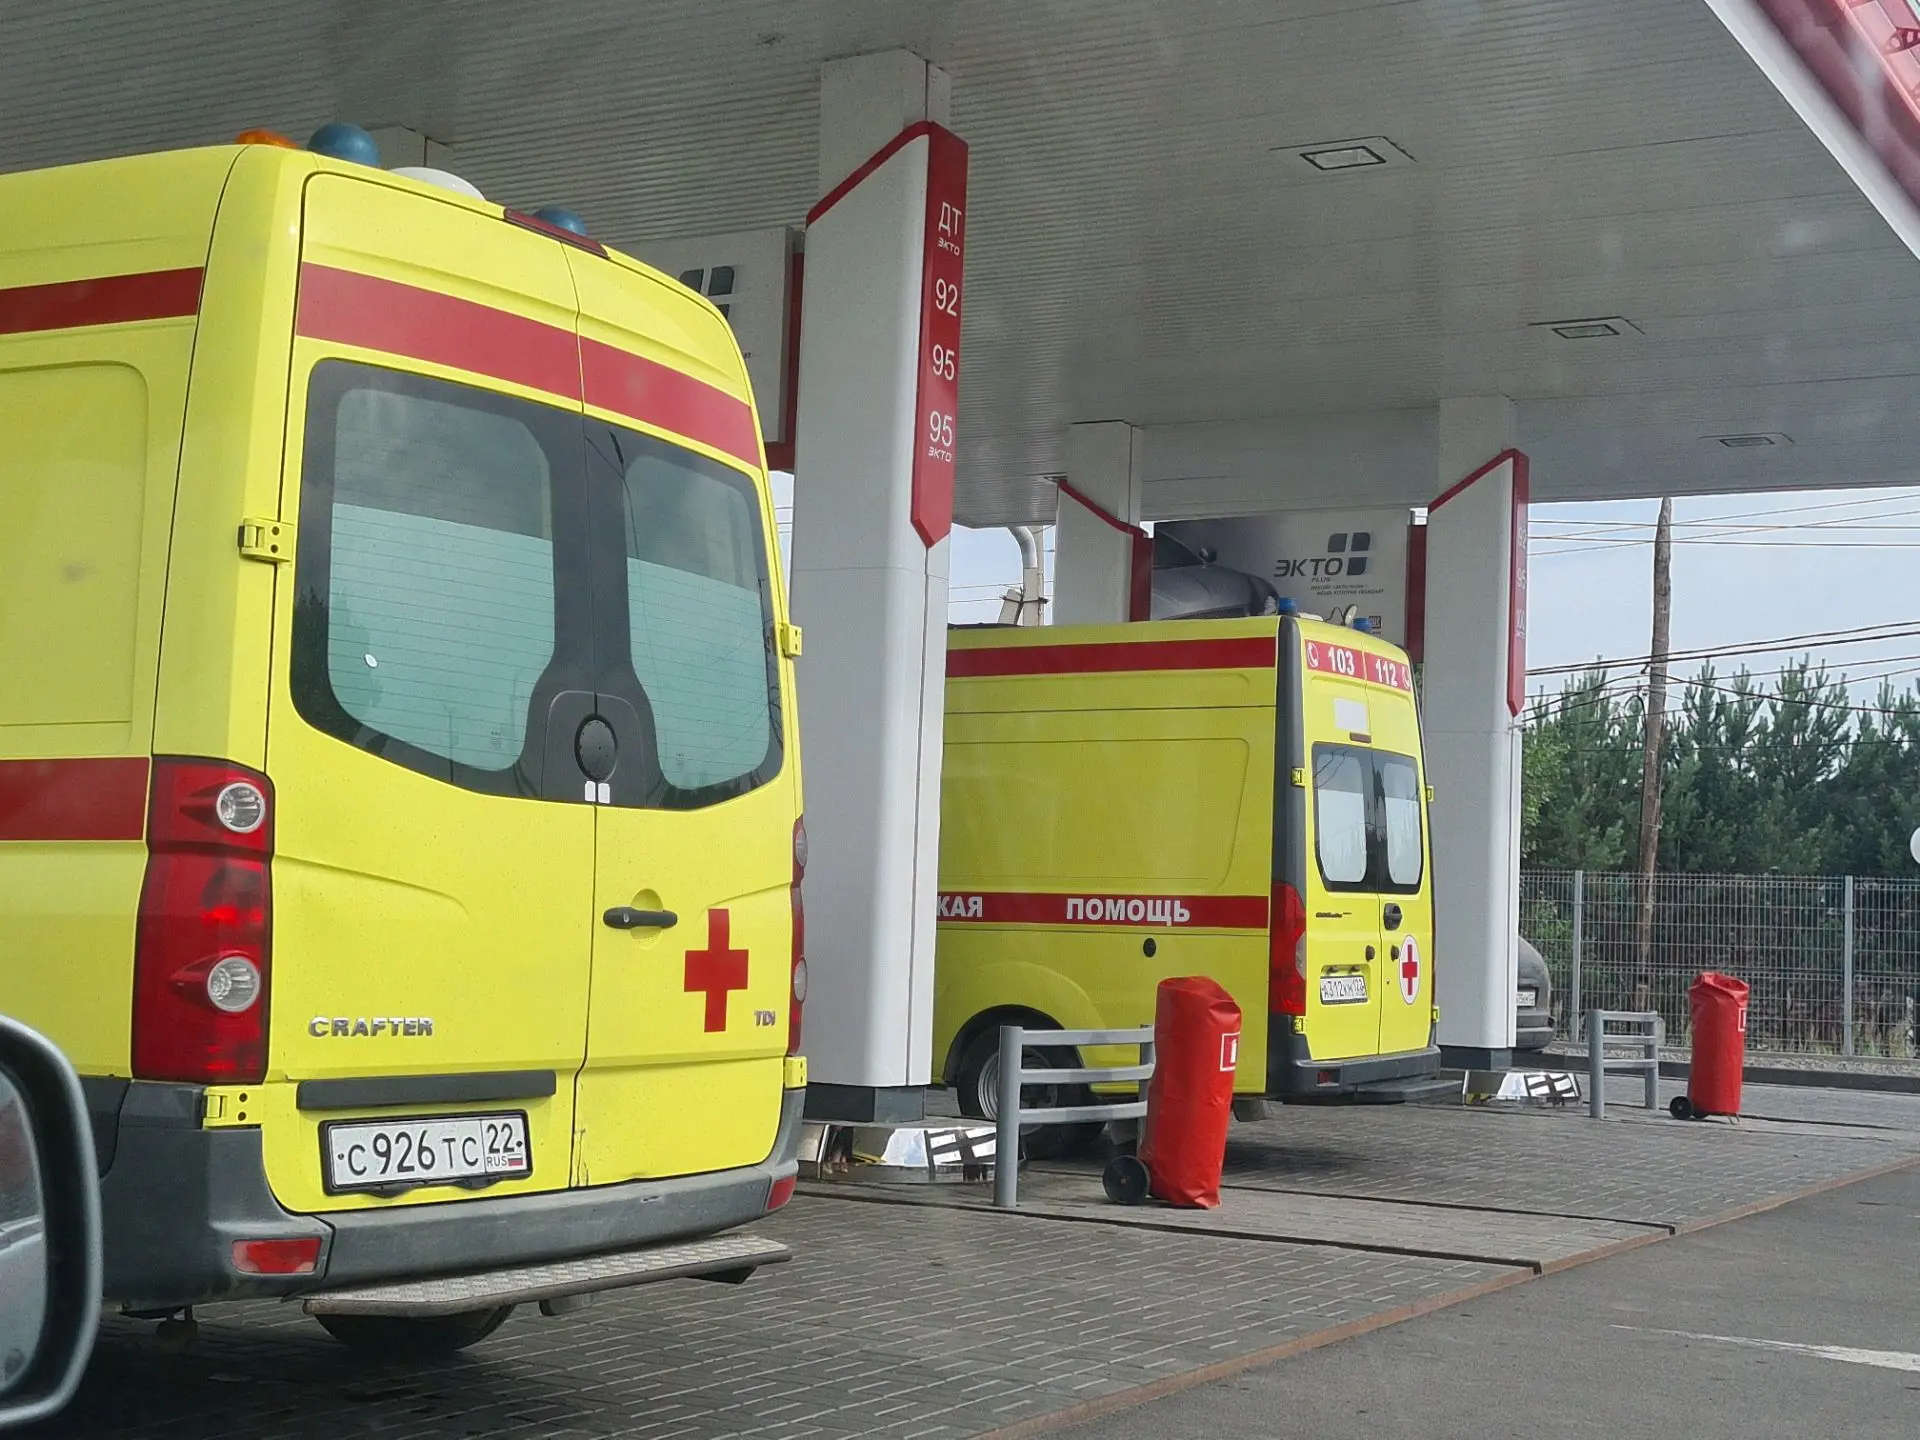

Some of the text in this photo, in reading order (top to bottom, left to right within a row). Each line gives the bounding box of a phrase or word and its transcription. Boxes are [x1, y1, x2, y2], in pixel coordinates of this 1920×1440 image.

[939, 201, 962, 237] ДТ
[938, 237, 960, 256] ЭКТО
[936, 278, 958, 317] 92
[933, 344, 955, 381] 95
[930, 411, 953, 447] 95
[928, 446, 952, 462] ЭКТО
[1273, 557, 1344, 577] ЭКТО
[1328, 646, 1355, 676] 103
[1376, 658, 1398, 687] 112
[1066, 898, 1191, 926] ПОМОЩЬ
[309, 1016, 433, 1037] CRAFTER
[754, 1010, 776, 1026] TDI
[486, 1123, 515, 1154] 22
[486, 1155, 508, 1168] RUS
